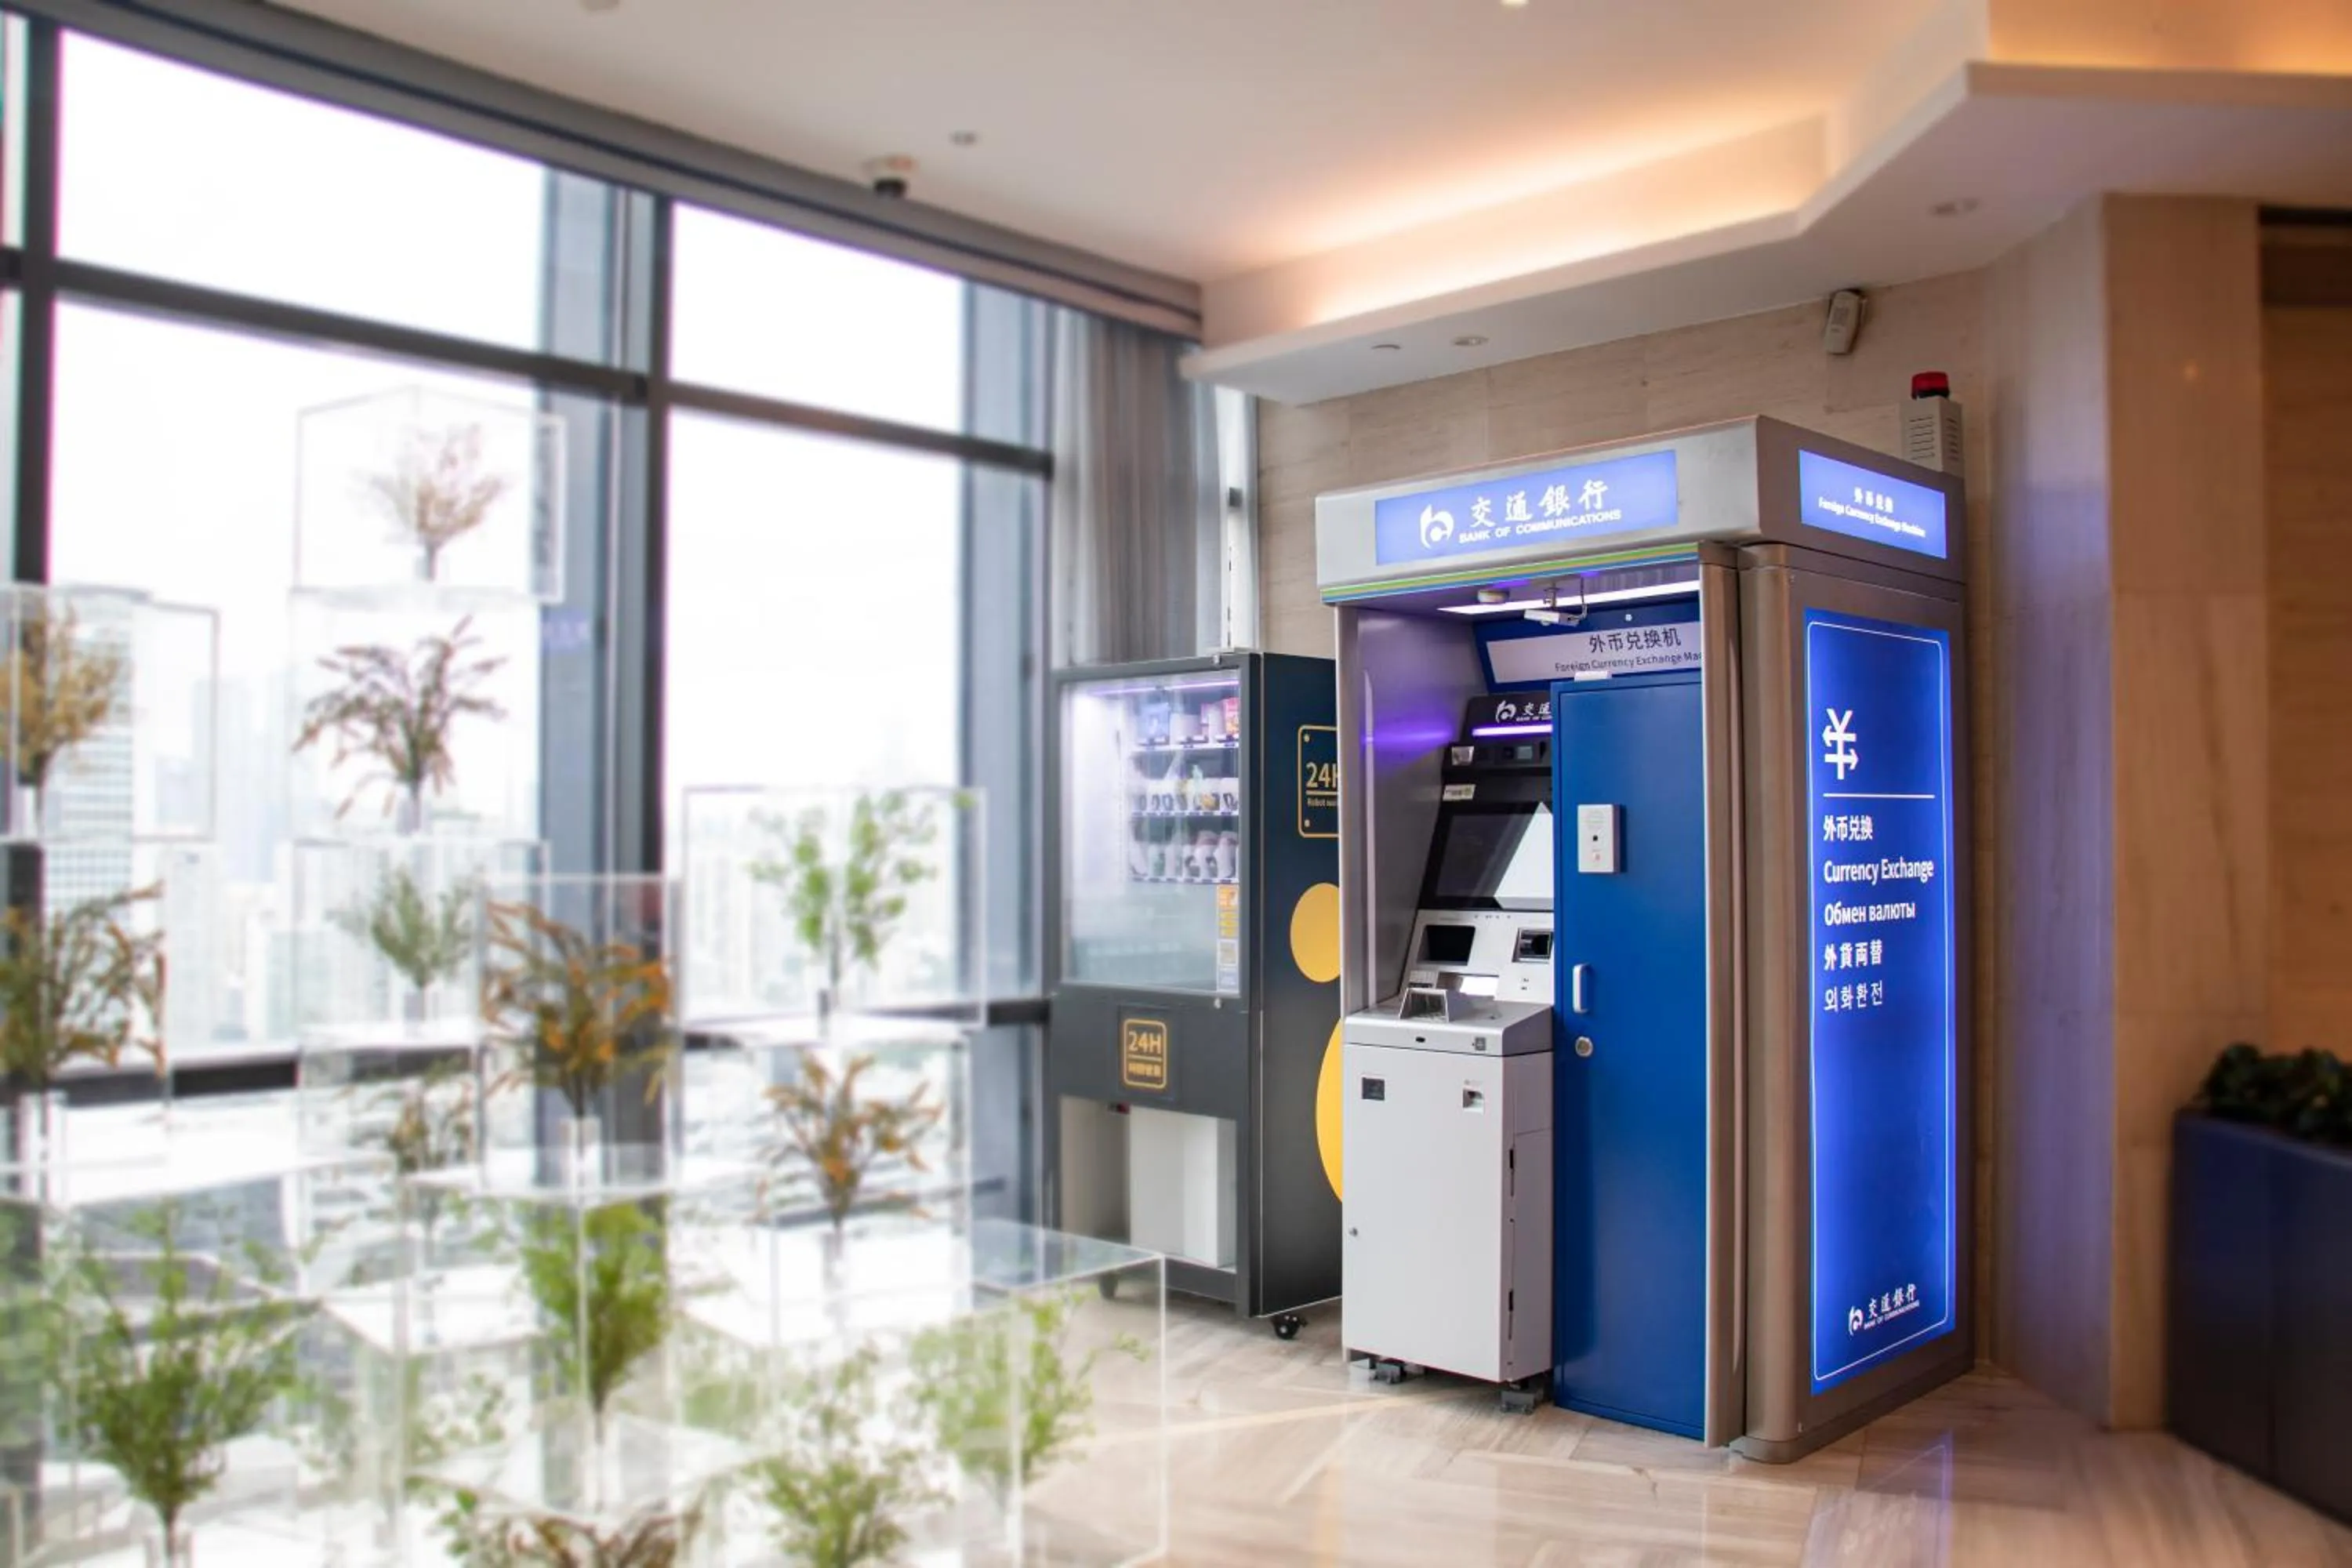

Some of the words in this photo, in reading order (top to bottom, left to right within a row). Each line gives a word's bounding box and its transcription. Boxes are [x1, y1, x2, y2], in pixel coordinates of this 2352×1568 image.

[1470, 479, 1609, 528] 交通銀行
[1459, 530, 1491, 543] BANK
[1495, 527, 1512, 538] OF
[1515, 510, 1622, 535] COMMUNICATIONS
[1589, 627, 1682, 653] 外币兑换机
[1555, 662, 1591, 672] Foreign
[1592, 658, 1635, 670] Currency
[1635, 654, 1682, 666] Exchange
[1823, 815, 1873, 841] 外币兑换
[1824, 860, 1878, 886] Currency
[1881, 856, 1934, 884] Exchange
[1824, 900, 1866, 926] Обмен
[1869, 902, 1915, 922] валюты
[1824, 939, 1882, 971] 外貨両替
[1824, 980, 1882, 1012] 외화환전
[1128, 1030, 1161, 1054] 24H
